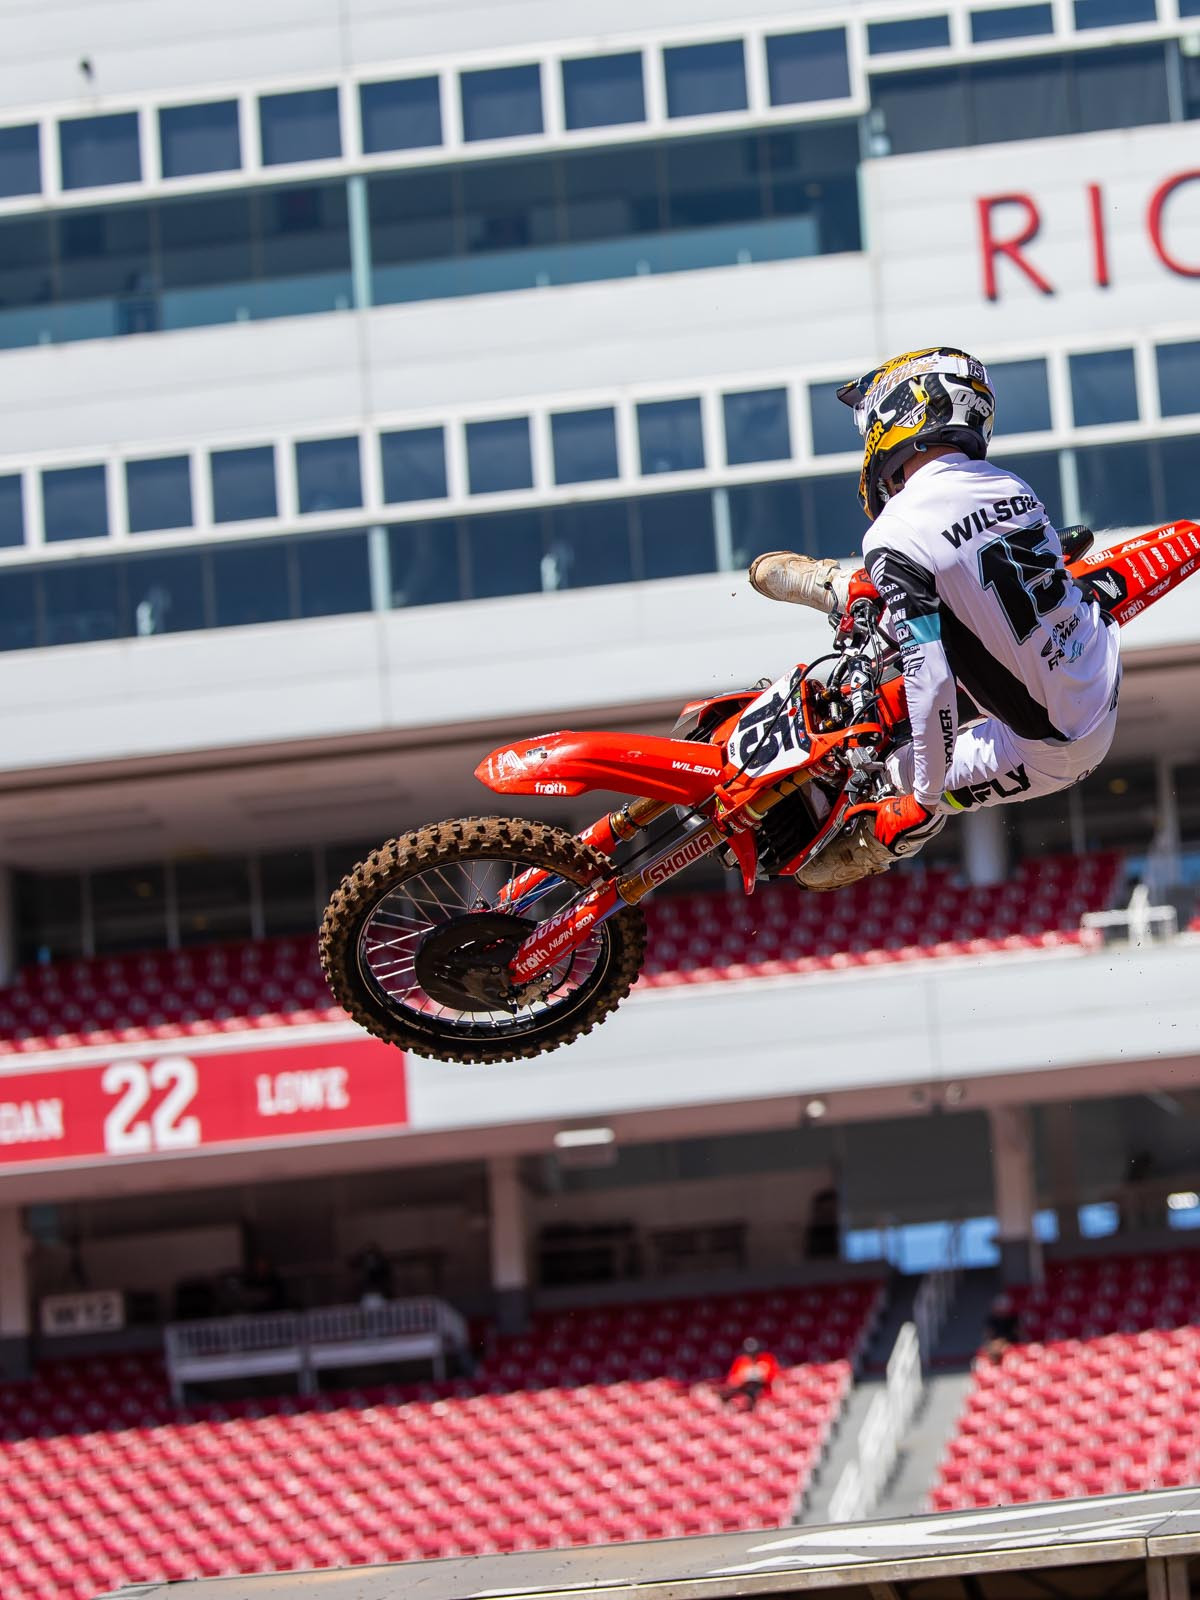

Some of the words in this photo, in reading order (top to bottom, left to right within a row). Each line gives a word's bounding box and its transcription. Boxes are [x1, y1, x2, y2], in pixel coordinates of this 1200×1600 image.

[976, 519, 1068, 645] 15
[1106, 571, 1122, 596] HONDA
[671, 760, 721, 777] WILSON
[649, 834, 714, 885] SHOWA
[102, 1058, 200, 1154] 22
[256, 1067, 350, 1116] LOWE
